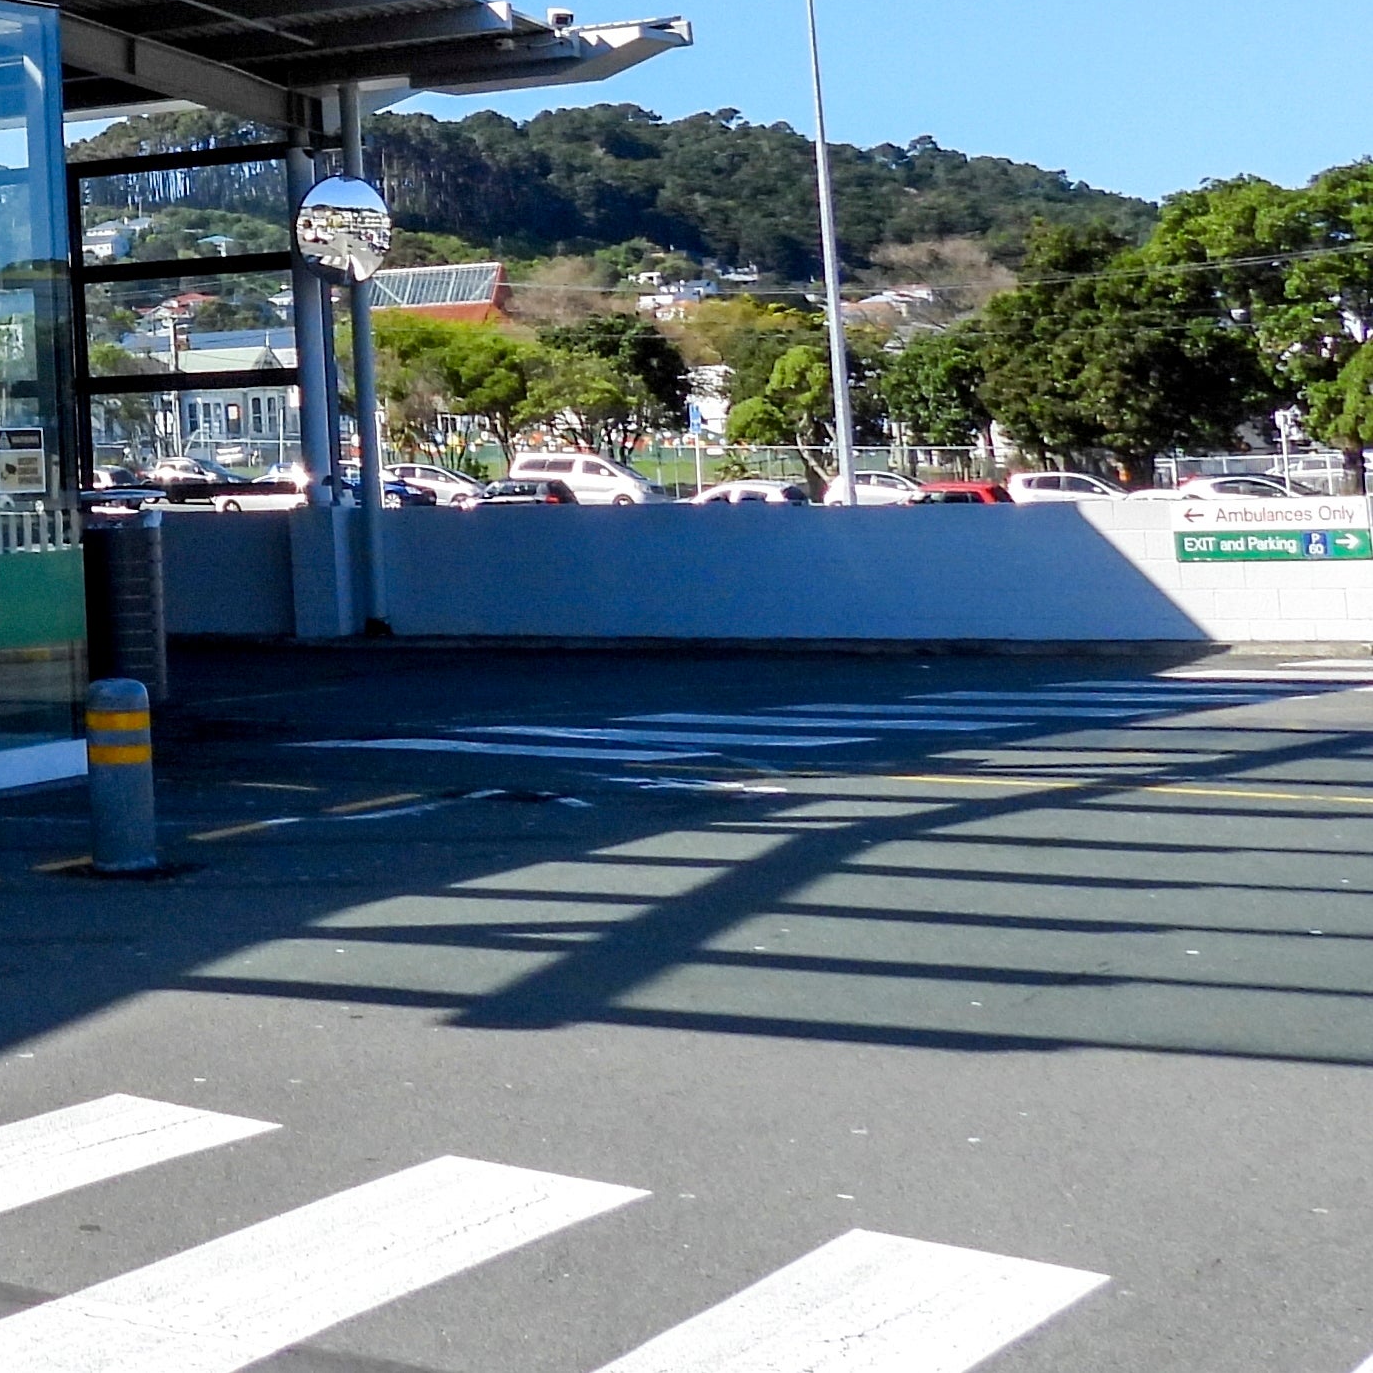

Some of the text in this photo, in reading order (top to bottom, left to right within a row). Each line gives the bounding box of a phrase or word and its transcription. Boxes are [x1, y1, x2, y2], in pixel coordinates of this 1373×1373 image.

[1215, 505, 1355, 524] Ambulances Only
[1183, 537, 1298, 554] EXIT and Parking
[1311, 533, 1321, 544] P
